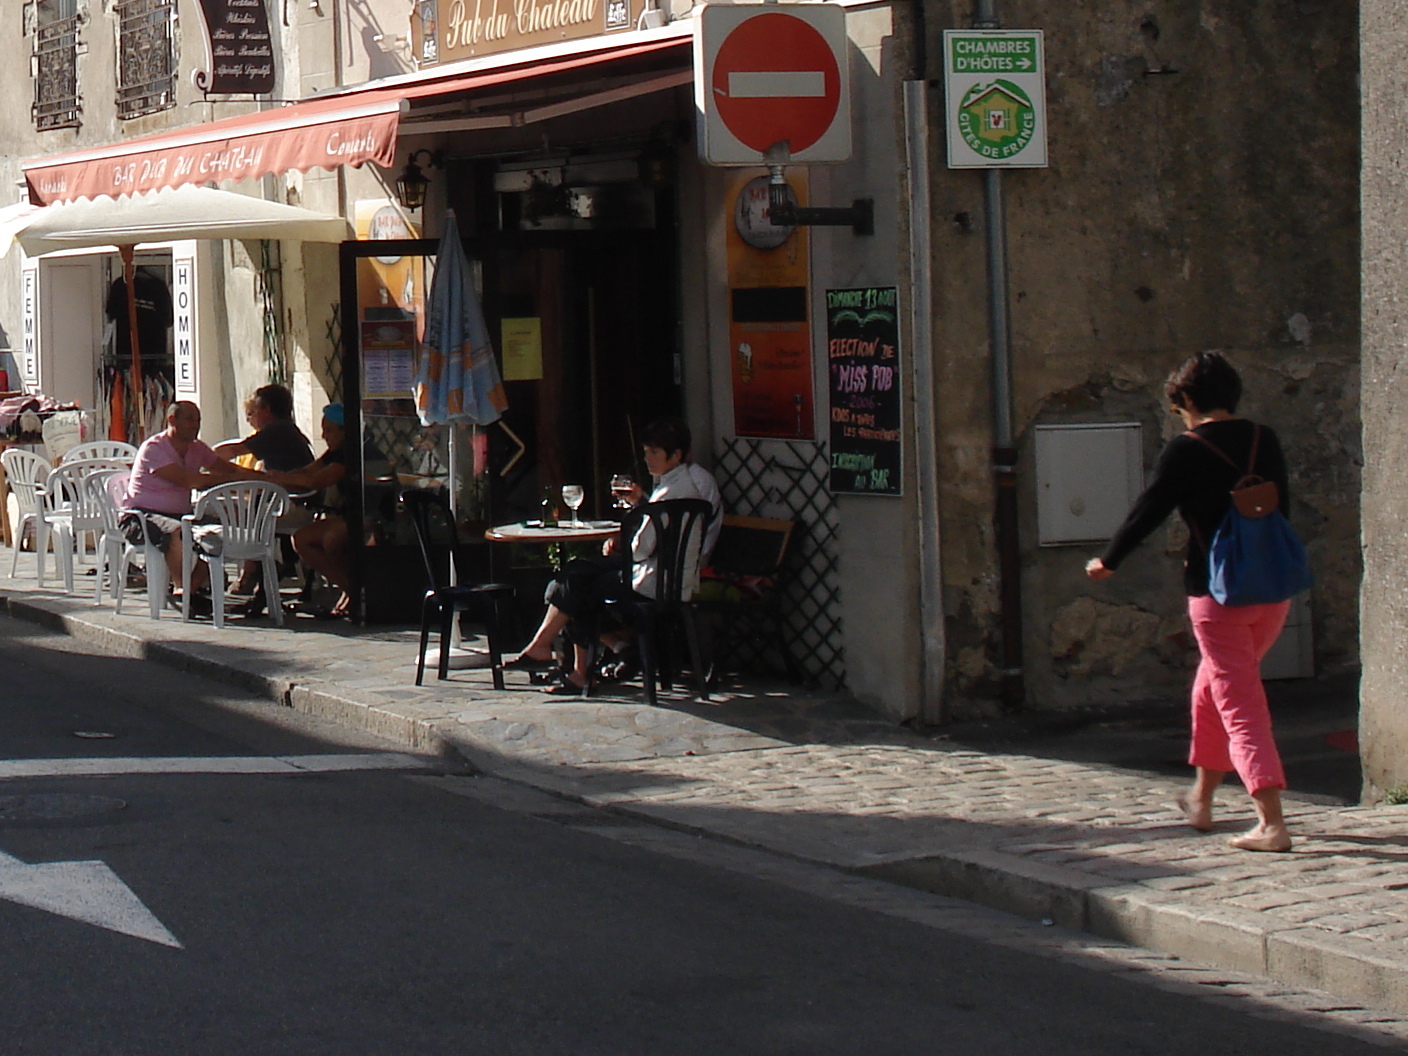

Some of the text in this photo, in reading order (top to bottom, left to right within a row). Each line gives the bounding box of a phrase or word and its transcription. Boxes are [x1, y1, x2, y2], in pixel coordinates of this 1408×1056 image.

[956, 41, 1031, 54] CHAMBRES
[957, 53, 1013, 70] D'HÔTES
[960, 111, 1033, 157] GITES DE FRANCE
[114, 145, 264, 186] BAR PUB DU CHATEAU
[864, 289, 878, 310] 13
[25, 277, 34, 375] FEMME
[178, 267, 190, 380] HOMME
[829, 337, 880, 358] ELECTION
